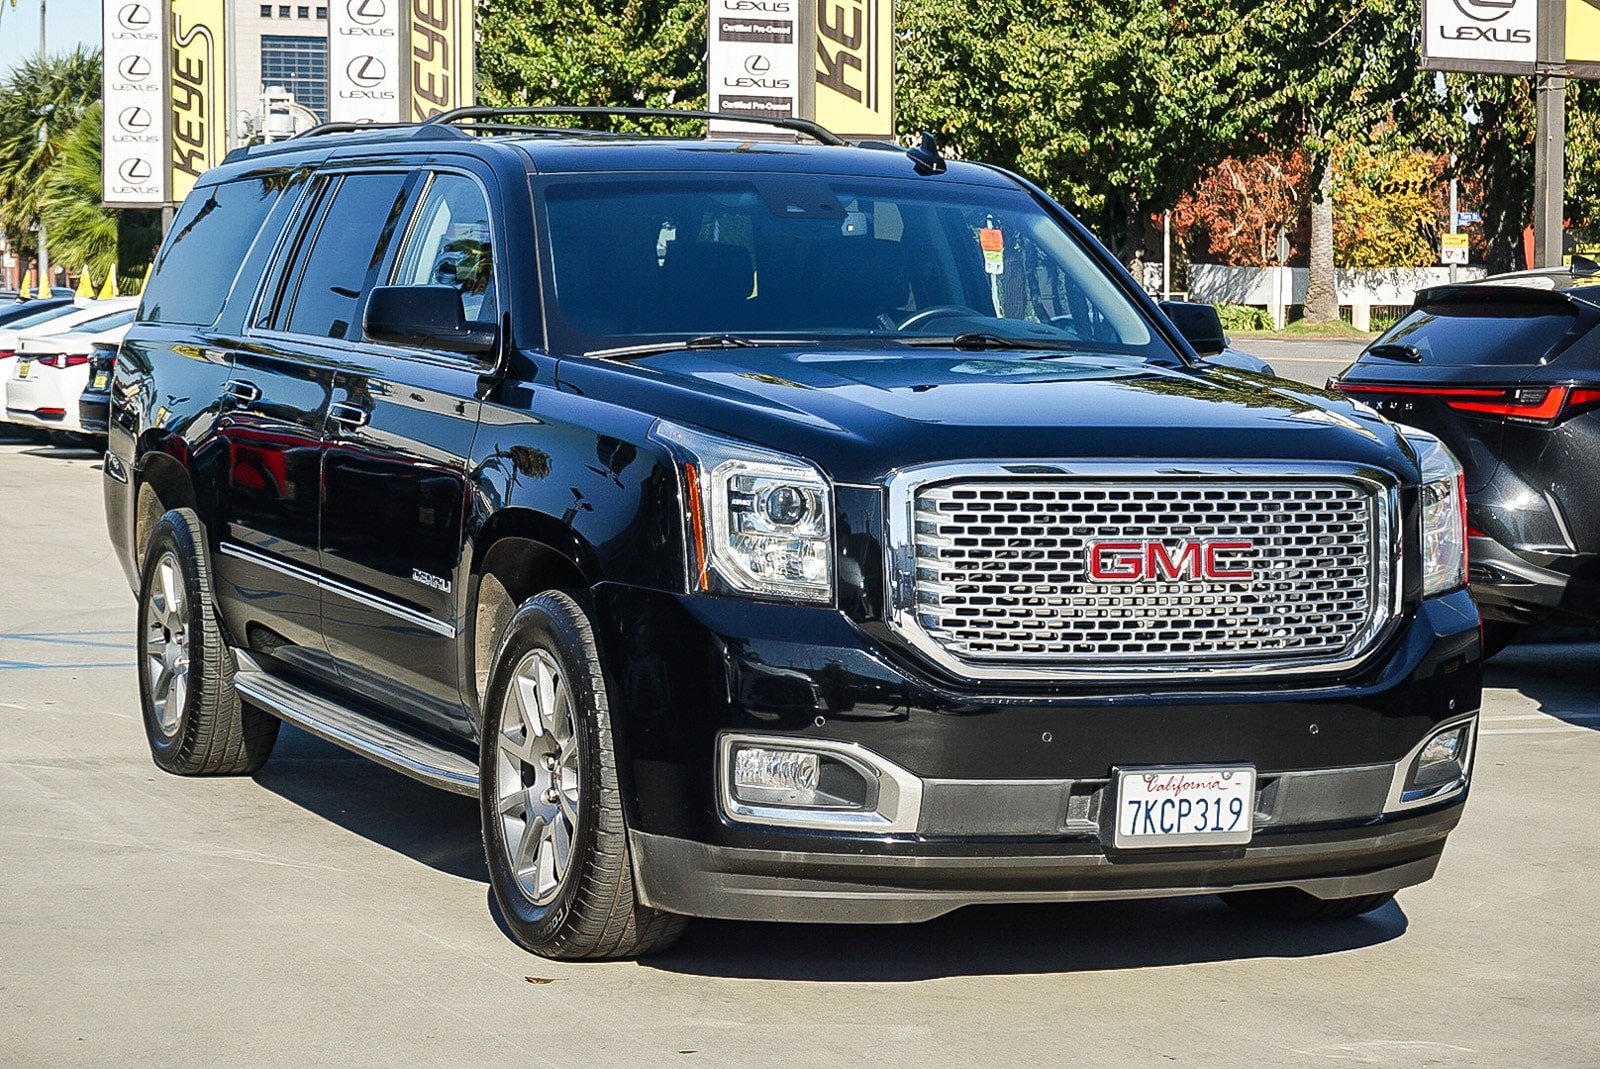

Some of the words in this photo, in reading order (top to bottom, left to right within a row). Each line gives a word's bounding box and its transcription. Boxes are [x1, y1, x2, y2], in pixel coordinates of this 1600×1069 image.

[724, 0, 790, 12] LEXUS
[111, 32, 159, 40] LEXUS
[339, 27, 394, 37] LEXUS
[1440, 25, 1531, 43] LEXUS
[816, 0, 862, 104] KE
[112, 83, 159, 91] LEXUS
[724, 77, 790, 88] LEXUS
[172, 13, 215, 178] KEYES
[339, 90, 394, 99] LEXUS
[1087, 539, 1253, 581] GMC
[1147, 775, 1228, 796] California
[1128, 797, 1243, 835] 7KCP319
